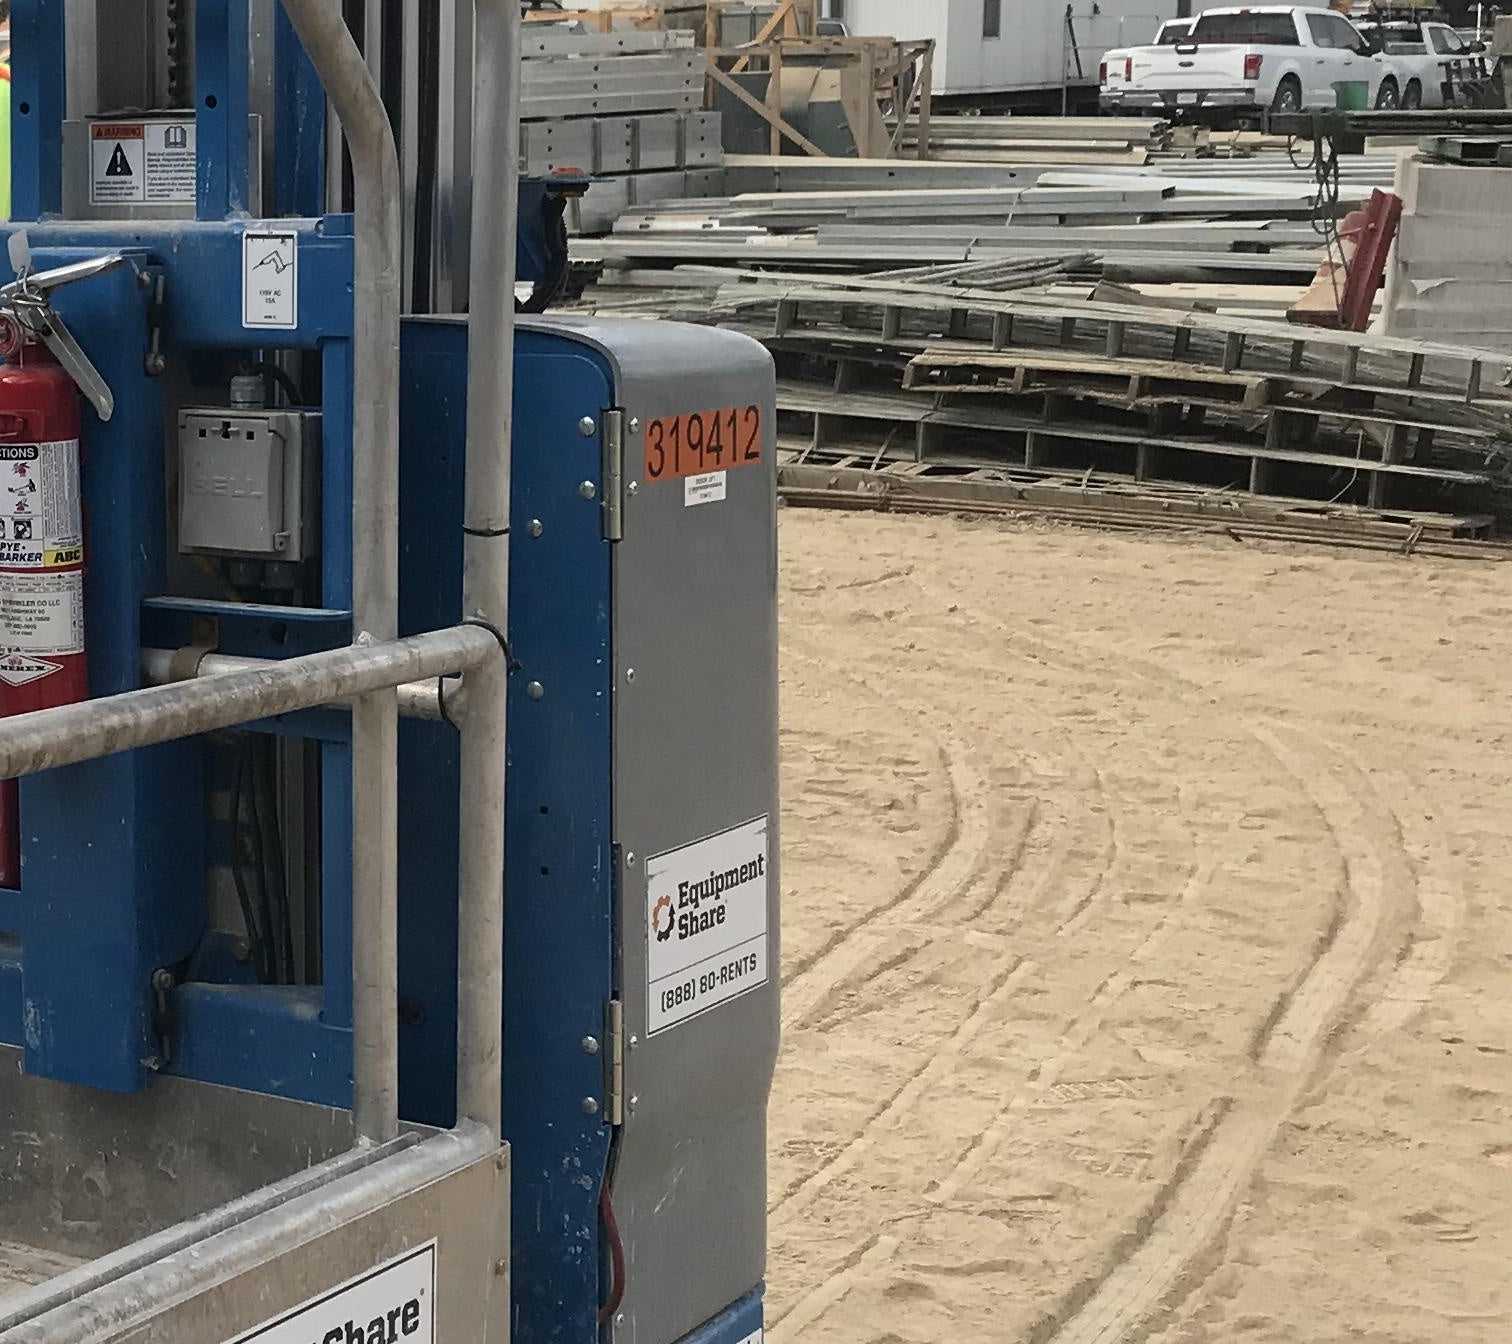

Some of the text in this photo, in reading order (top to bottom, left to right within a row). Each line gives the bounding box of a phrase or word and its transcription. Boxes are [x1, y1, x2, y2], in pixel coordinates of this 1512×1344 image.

[648, 405, 759, 477] 319412
[0, 552, 42, 562] BARKER
[54, 549, 81, 563] ABC
[678, 853, 764, 910] Equipment
[678, 904, 726, 940] Share
[661, 953, 757, 1013] (888) 80-RENTS
